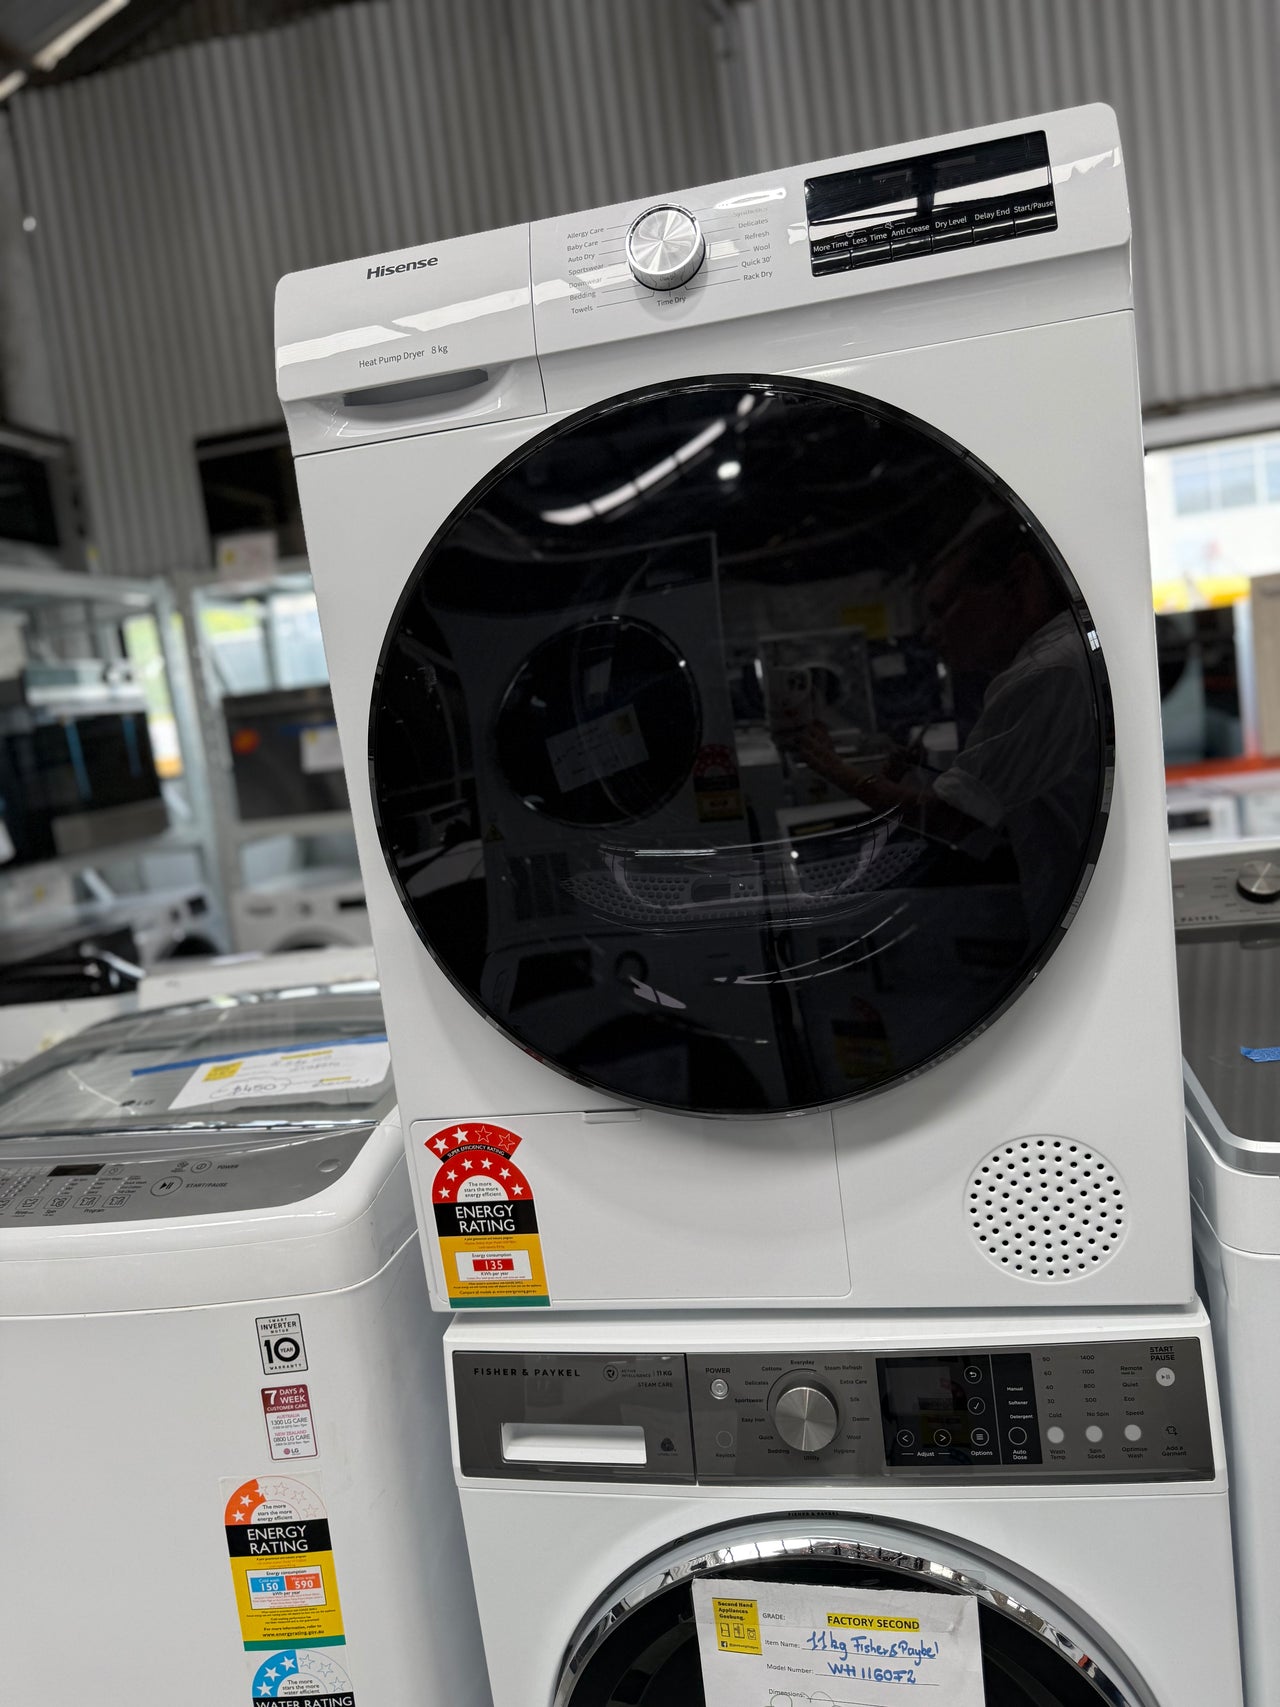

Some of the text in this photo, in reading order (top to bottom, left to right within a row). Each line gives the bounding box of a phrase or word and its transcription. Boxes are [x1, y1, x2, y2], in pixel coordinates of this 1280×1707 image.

[1014, 199, 1054, 214] Start/Pause
[974, 207, 1011, 221] Delay End
[739, 219, 769, 229] Delicates
[935, 216, 968, 230] Dry Level
[567, 227, 604, 240] Allergy Care
[745, 231, 770, 240] Refresh
[891, 224, 930, 238] Anti Crease
[852, 232, 888, 245] Less Time
[567, 240, 599, 252] Baby Care
[753, 243, 771, 252] Wool
[813, 240, 849, 253] More Time
[568, 253, 596, 263] Auto Dry
[741, 259, 761, 269] Quick
[366, 257, 439, 280] Hisense
[568, 264, 604, 277] Sportswear
[743, 270, 773, 282] Rack Dry
[569, 277, 603, 289] Downwear
[570, 290, 597, 302] Bedding
[657, 296, 686, 307] Time Dry
[571, 305, 594, 315] Towels
[359, 344, 449, 368] Heat Pump Dryer 8 kg
[455, 1204, 514, 1219] ENERGY
[459, 1219, 516, 1234] RATING
[485, 1260, 504, 1271] 135
[261, 1321, 297, 1330] INVERTER
[264, 1337, 301, 1364] 10
[474, 1368, 581, 1377] FISHER & PAYKEL
[265, 1390, 278, 1406] 7
[280, 1388, 298, 1396] DAYS
[280, 1395, 307, 1404] WEEK
[247, 1525, 307, 1541] ENERGY
[250, 1540, 309, 1555] RATING
[261, 1582, 279, 1592] 150
[295, 1580, 314, 1590] 590
[762, 1613, 786, 1621] GRADE:
[827, 1615, 920, 1630] FACTORY SECOND
[780, 1641, 800, 1649] Name:
[767, 1663, 814, 1675] Model Number:
[304, 1697, 353, 1707] RATING
